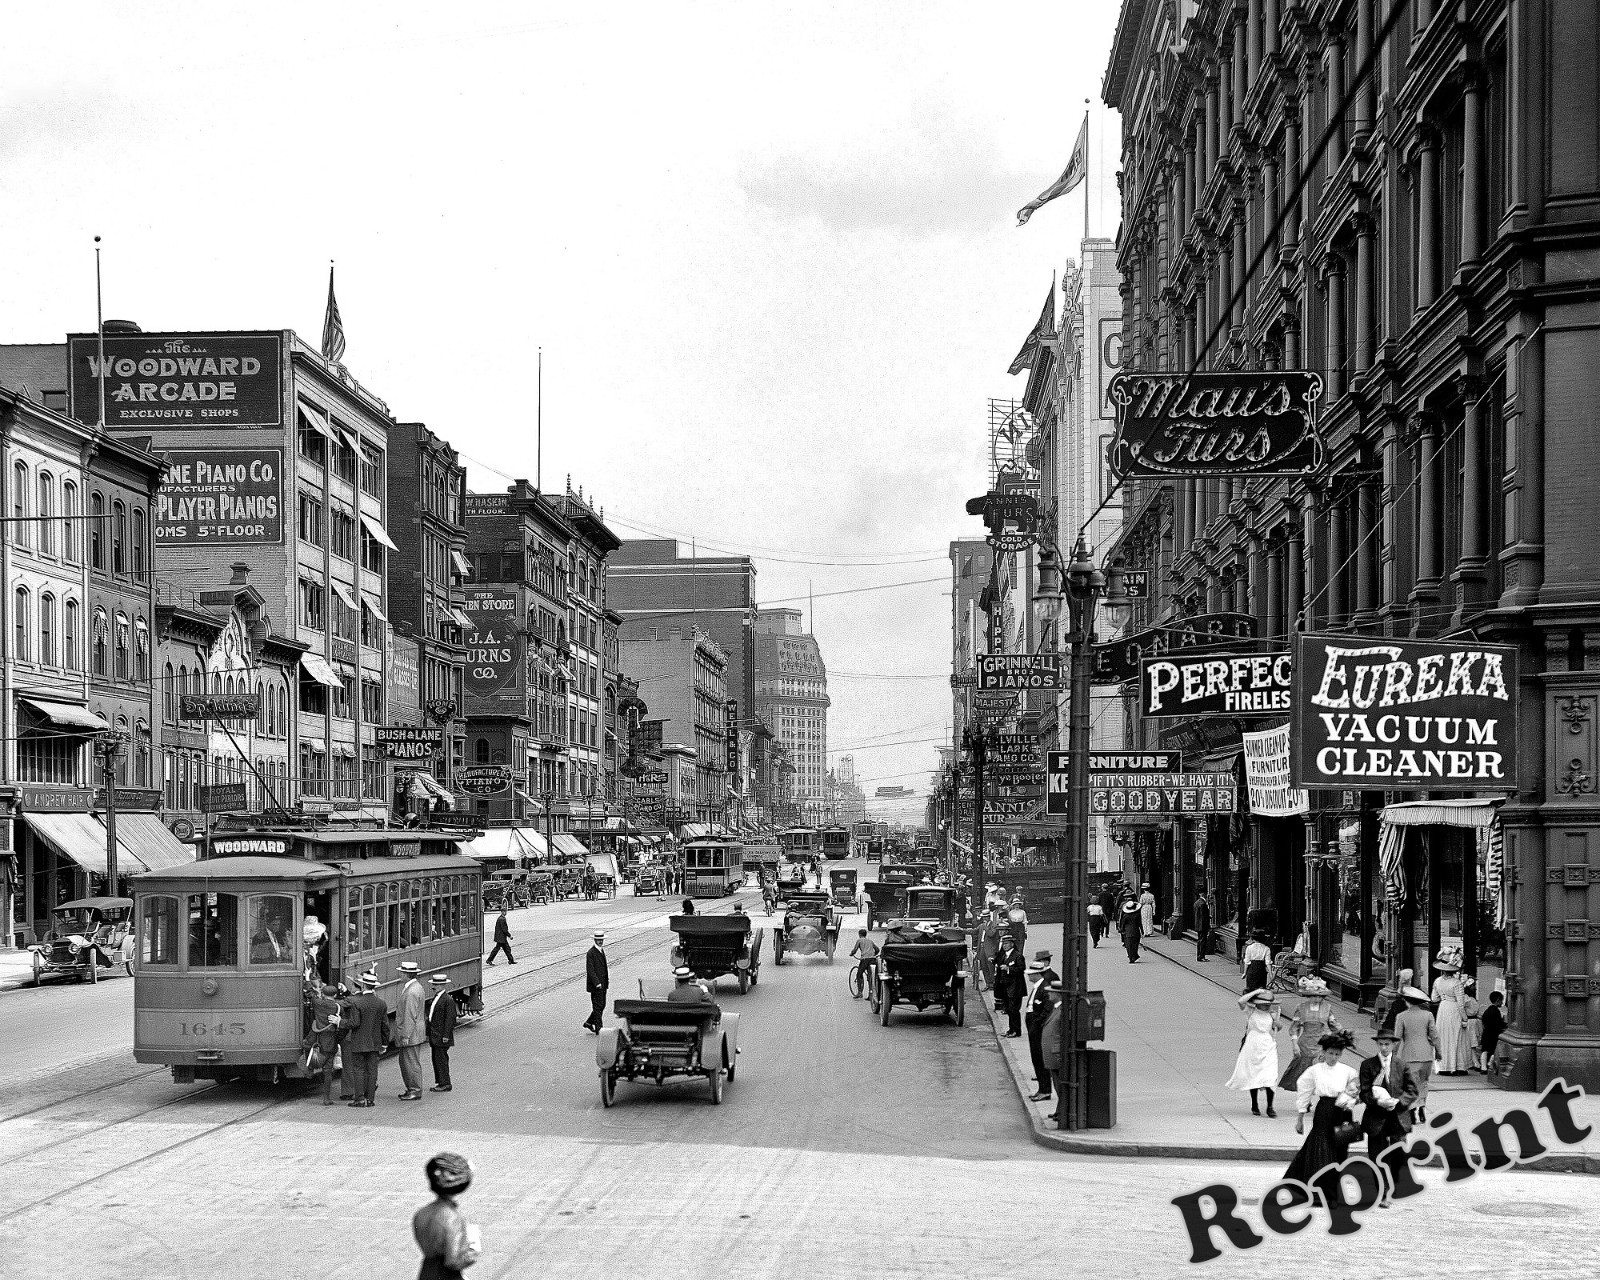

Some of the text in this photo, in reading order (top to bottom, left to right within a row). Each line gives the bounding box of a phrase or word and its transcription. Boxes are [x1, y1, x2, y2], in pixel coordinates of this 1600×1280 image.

[163, 340, 191, 354] The
[86, 355, 261, 378] WOODWARD
[111, 381, 237, 402] ARCADE
[120, 408, 239, 418] EXCLUSIVE SHOPS
[1153, 420, 1271, 462] Furs
[196, 460, 247, 484] PIANO
[992, 507, 1034, 523] FURS
[989, 537, 1034, 550] STORAGE
[482, 599, 515, 611] STORE
[983, 656, 1058, 673] GRINNELL
[472, 666, 498, 679] CO.
[1311, 644, 1509, 709] EUREKA
[986, 675, 1054, 688] PIANOS
[377, 729, 406, 740] BUSH
[415, 729, 442, 740] LANE
[1318, 712, 1498, 745] VACUUM
[1000, 735, 1038, 744] LVILLE
[386, 742, 432, 758] PIANOS
[1000, 745, 1030, 753] LARK
[1058, 756, 1168, 769] FRNITURE
[1316, 747, 1505, 779] CLEANER
[465, 777, 501, 786] PIANO
[1106, 773, 1124, 786] IT'S
[1189, 773, 1215, 786] HAVE
[1093, 790, 1232, 811] GOODYEAR
[213, 840, 286, 854] WOODWARD
[180, 1022, 246, 1036] 1645
